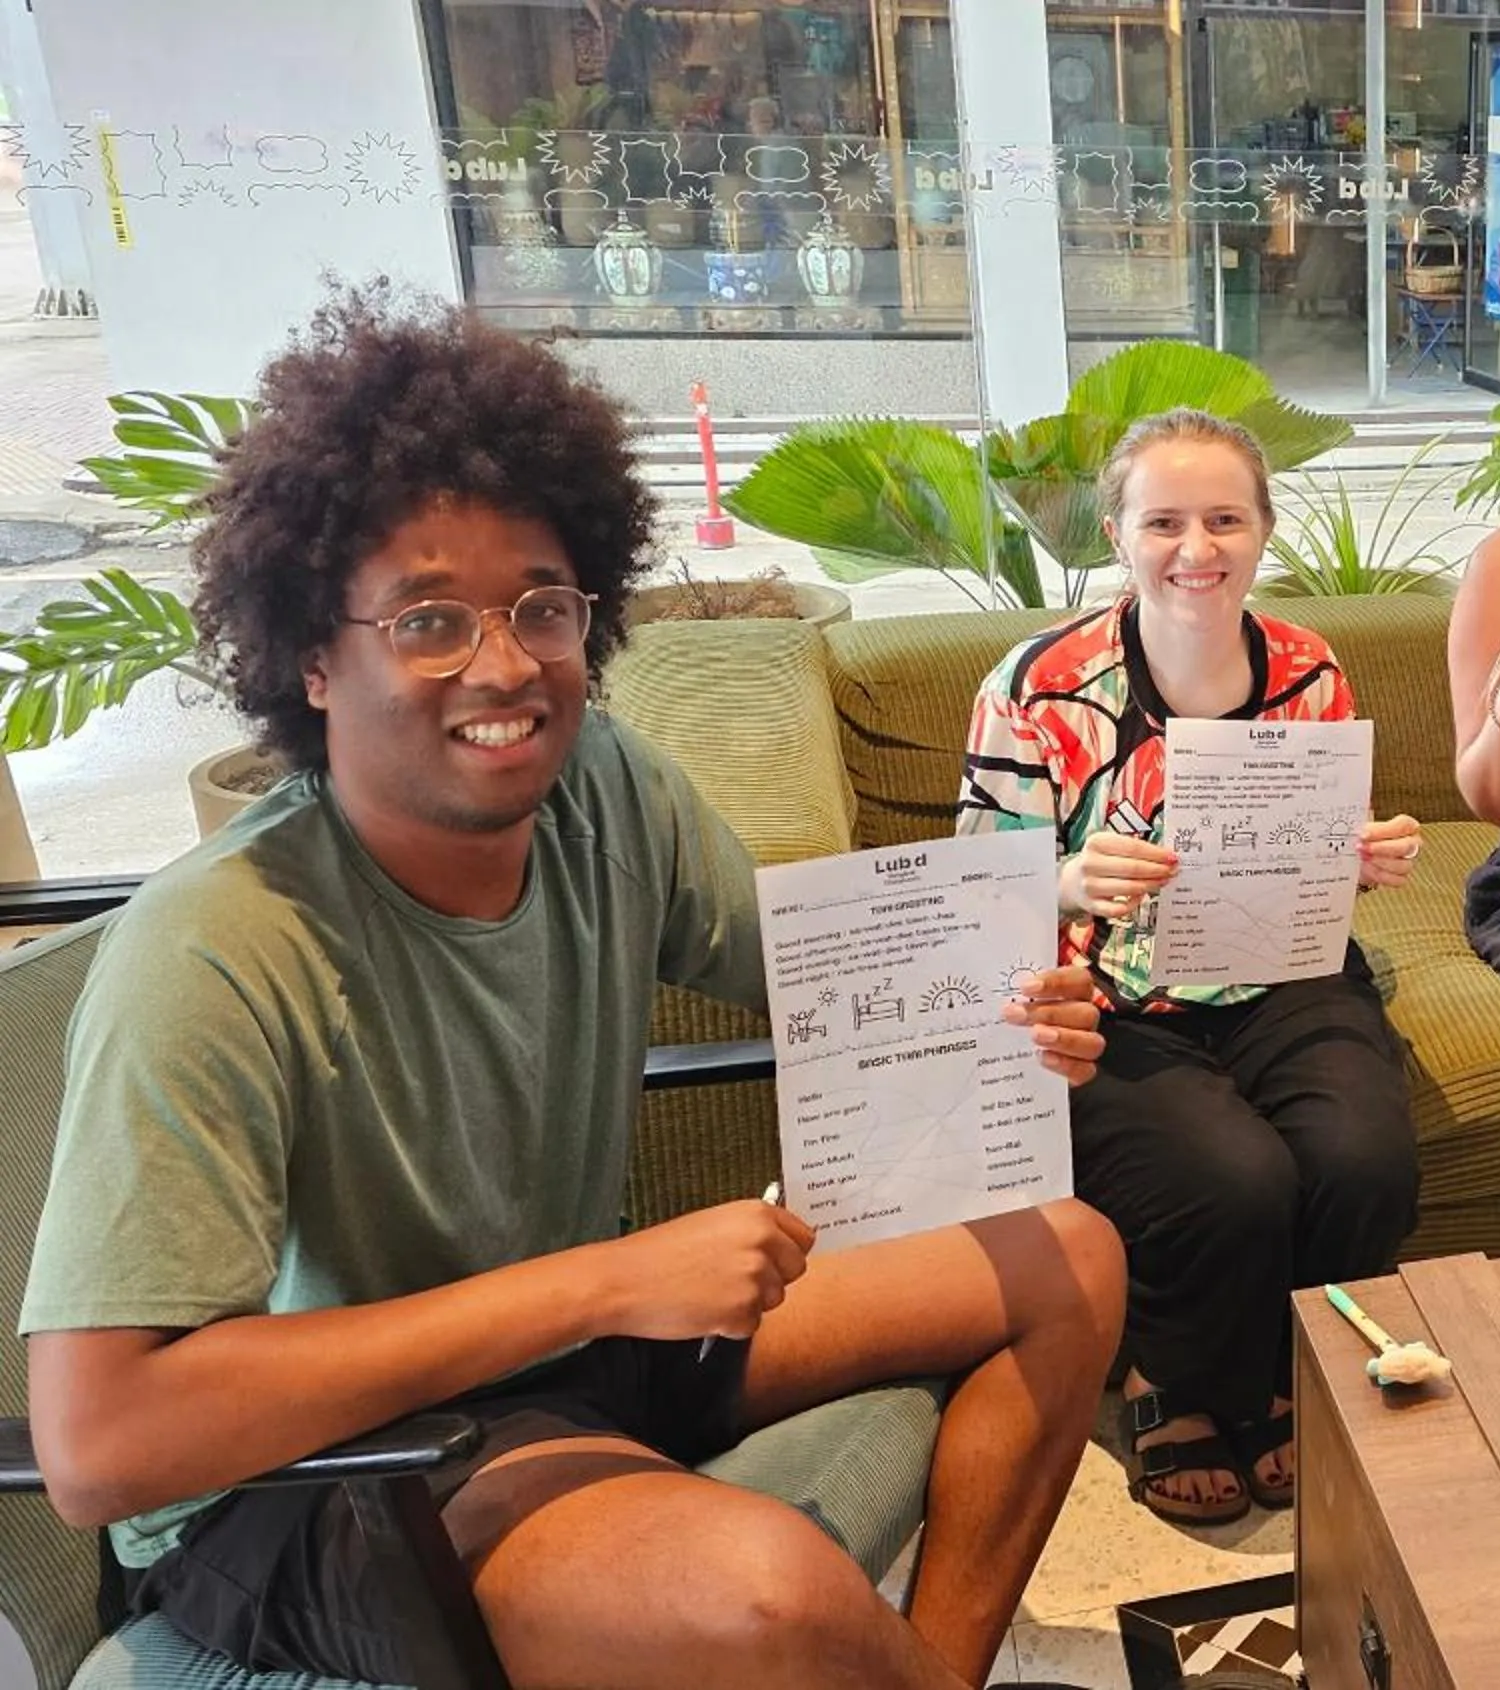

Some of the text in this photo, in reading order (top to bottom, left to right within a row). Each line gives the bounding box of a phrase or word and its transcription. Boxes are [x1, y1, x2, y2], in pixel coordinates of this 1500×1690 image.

[875, 853, 928, 874] Lub d
[857, 1052, 893, 1070] BASIC
[923, 1040, 978, 1059] PHRASES
[807, 1173, 857, 1192] thank you
